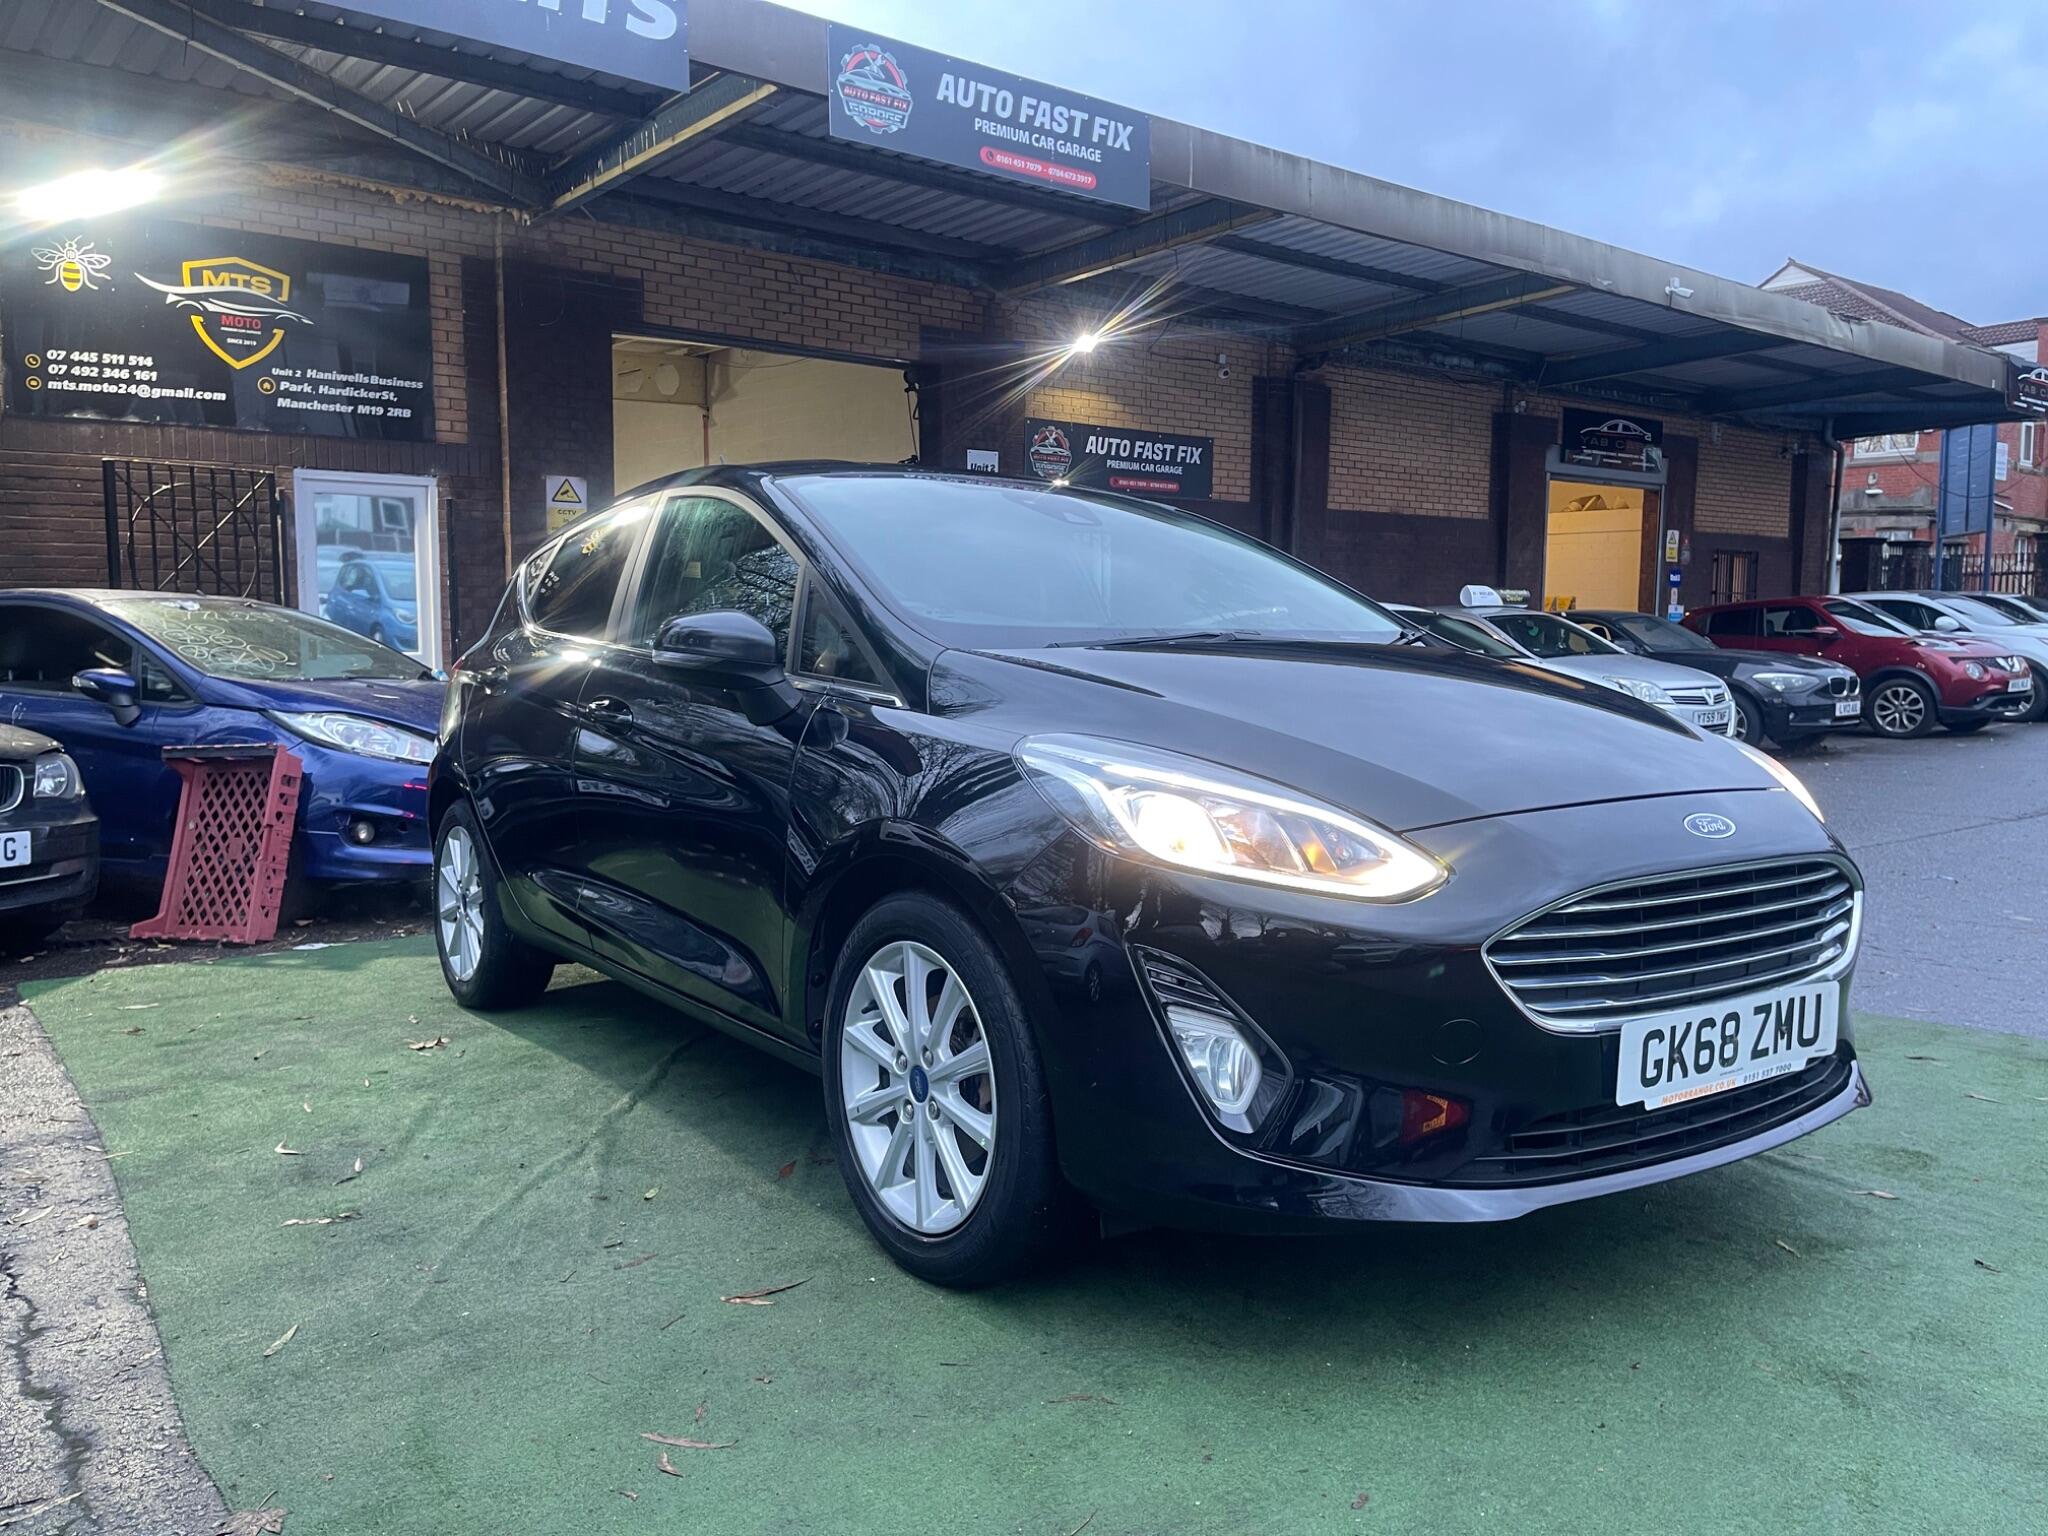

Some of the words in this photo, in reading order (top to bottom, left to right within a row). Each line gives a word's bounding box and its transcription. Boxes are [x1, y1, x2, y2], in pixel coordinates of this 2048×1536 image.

[844, 86, 869, 100] AUTO
[869, 92, 893, 106] FAST
[893, 98, 908, 112] FIX
[936, 72, 1013, 119] AUTO
[1019, 95, 1088, 138] FAST
[1092, 116, 1134, 152] FIX
[974, 117, 1030, 144] PREMIUM
[1031, 133, 1055, 150] CAR
[1056, 140, 1102, 163] GARAGE
[202, 269, 272, 294] MTS
[220, 314, 262, 329] MOTO
[46, 349, 67, 361] 07
[69, 351, 99, 363] 445
[101, 353, 126, 365] 511
[127, 355, 154, 368] 514
[47, 364, 68, 375] 07
[70, 366, 99, 378] 492
[101, 368, 130, 380] 346
[133, 370, 158, 382] 161
[271, 367, 293, 377] Unit
[294, 370, 302, 378] 2
[47, 379, 227, 401] mts.moto24@gmail.com
[276, 398, 354, 414] Manchester
[356, 404, 384, 416] M19
[386, 407, 412, 418] 2RB
[1085, 435, 1131, 458] AUTO
[1133, 440, 1175, 462] FAST
[1176, 445, 1203, 465] FIX
[1106, 459, 1140, 471] PREMIUM
[1140, 463, 1155, 473] CAR
[1155, 464, 1183, 475] GARAGE
[1695, 818, 1726, 833] Ford
[1640, 1011, 1741, 1089] GK68
[1750, 993, 1822, 1061] ZMU
